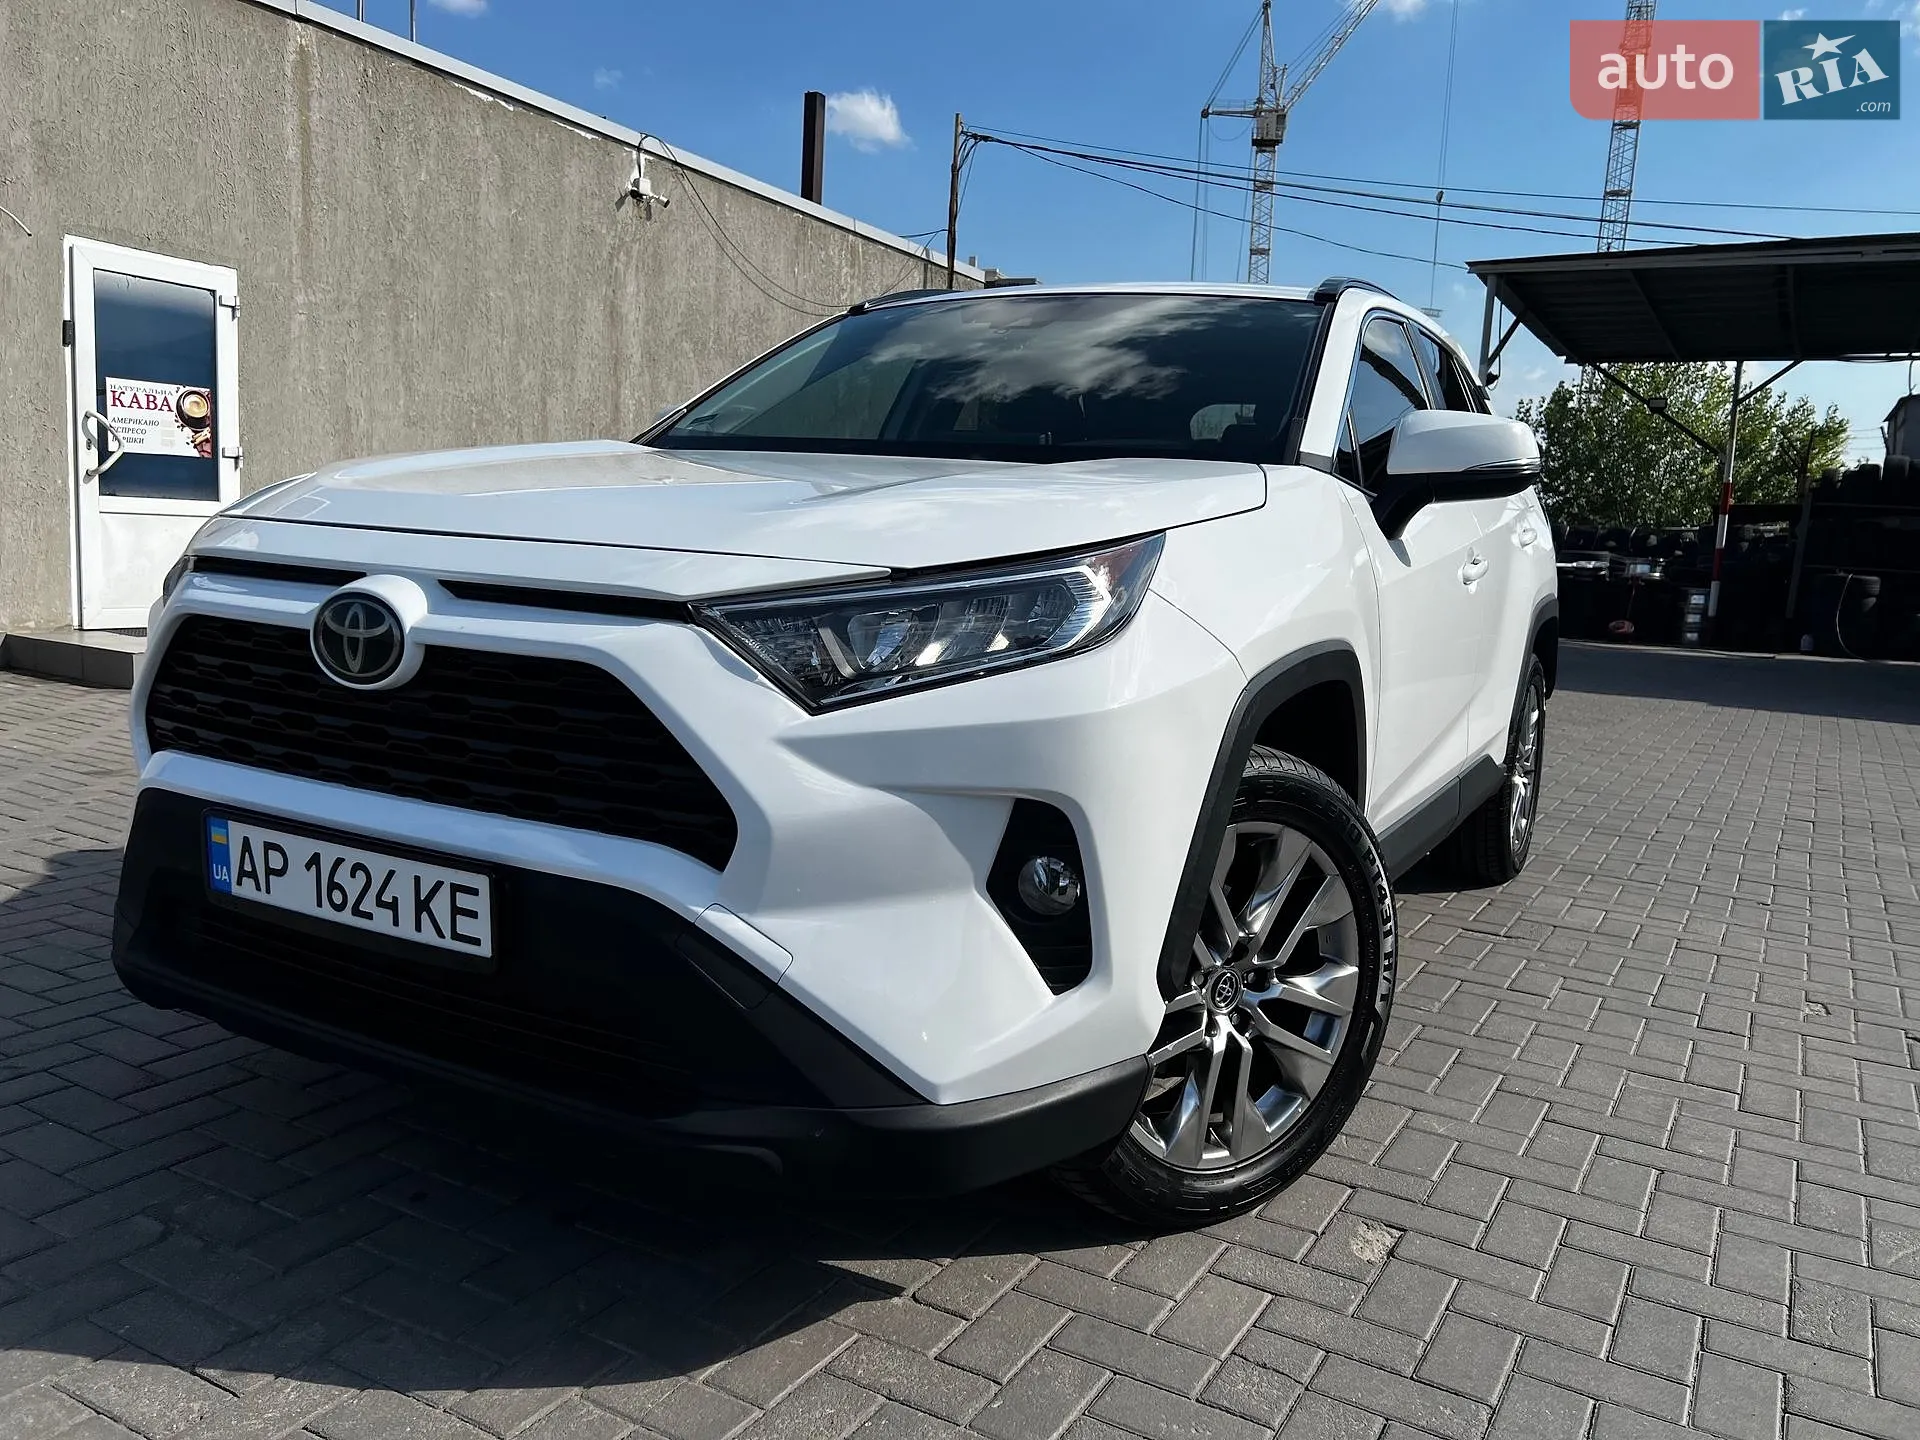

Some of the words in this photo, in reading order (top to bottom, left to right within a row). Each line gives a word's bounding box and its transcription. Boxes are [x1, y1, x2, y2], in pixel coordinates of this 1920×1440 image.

[110, 384, 174, 396] НАТУРАЛЬНА
[110, 390, 174, 413] КАВА
[111, 417, 160, 427] АМЕРИКАНО
[112, 426, 147, 435] СПРЕСО
[213, 863, 230, 883] UA
[236, 836, 289, 895] AP
[304, 851, 400, 927] 1624
[414, 874, 482, 947] KE
